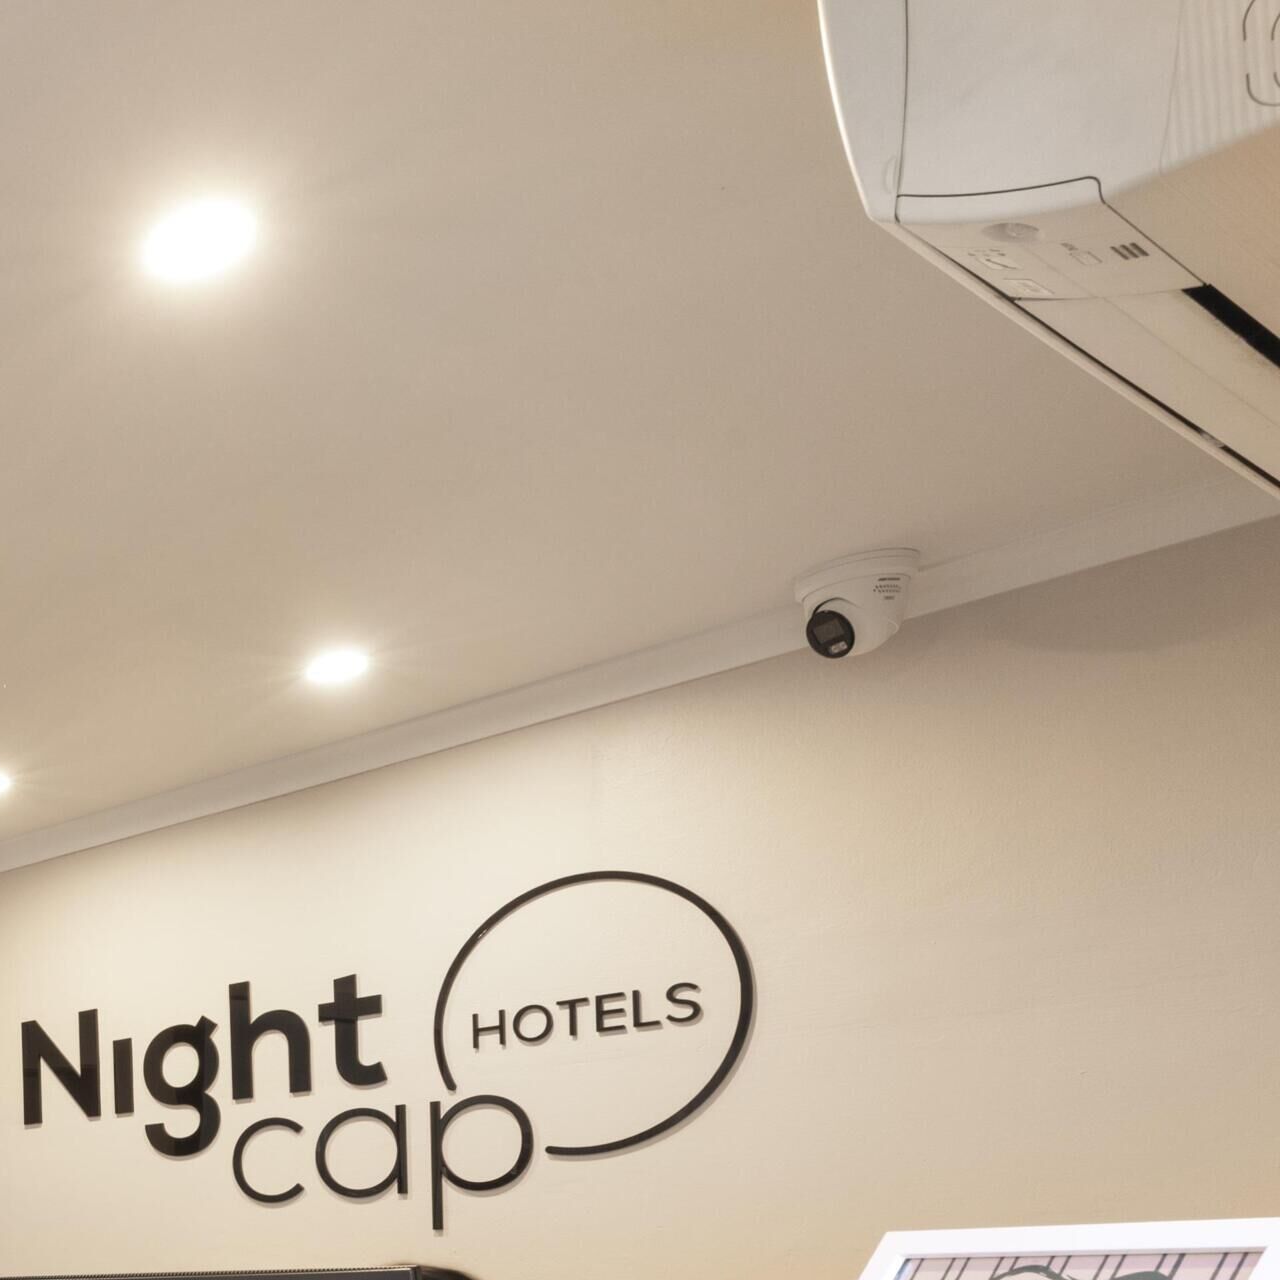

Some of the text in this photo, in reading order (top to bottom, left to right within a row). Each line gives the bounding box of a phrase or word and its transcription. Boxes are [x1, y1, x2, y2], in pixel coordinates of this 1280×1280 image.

[20, 973, 388, 1158] Night
[472, 982, 704, 1051] HOTELS
[232, 1093, 535, 1233] cap
